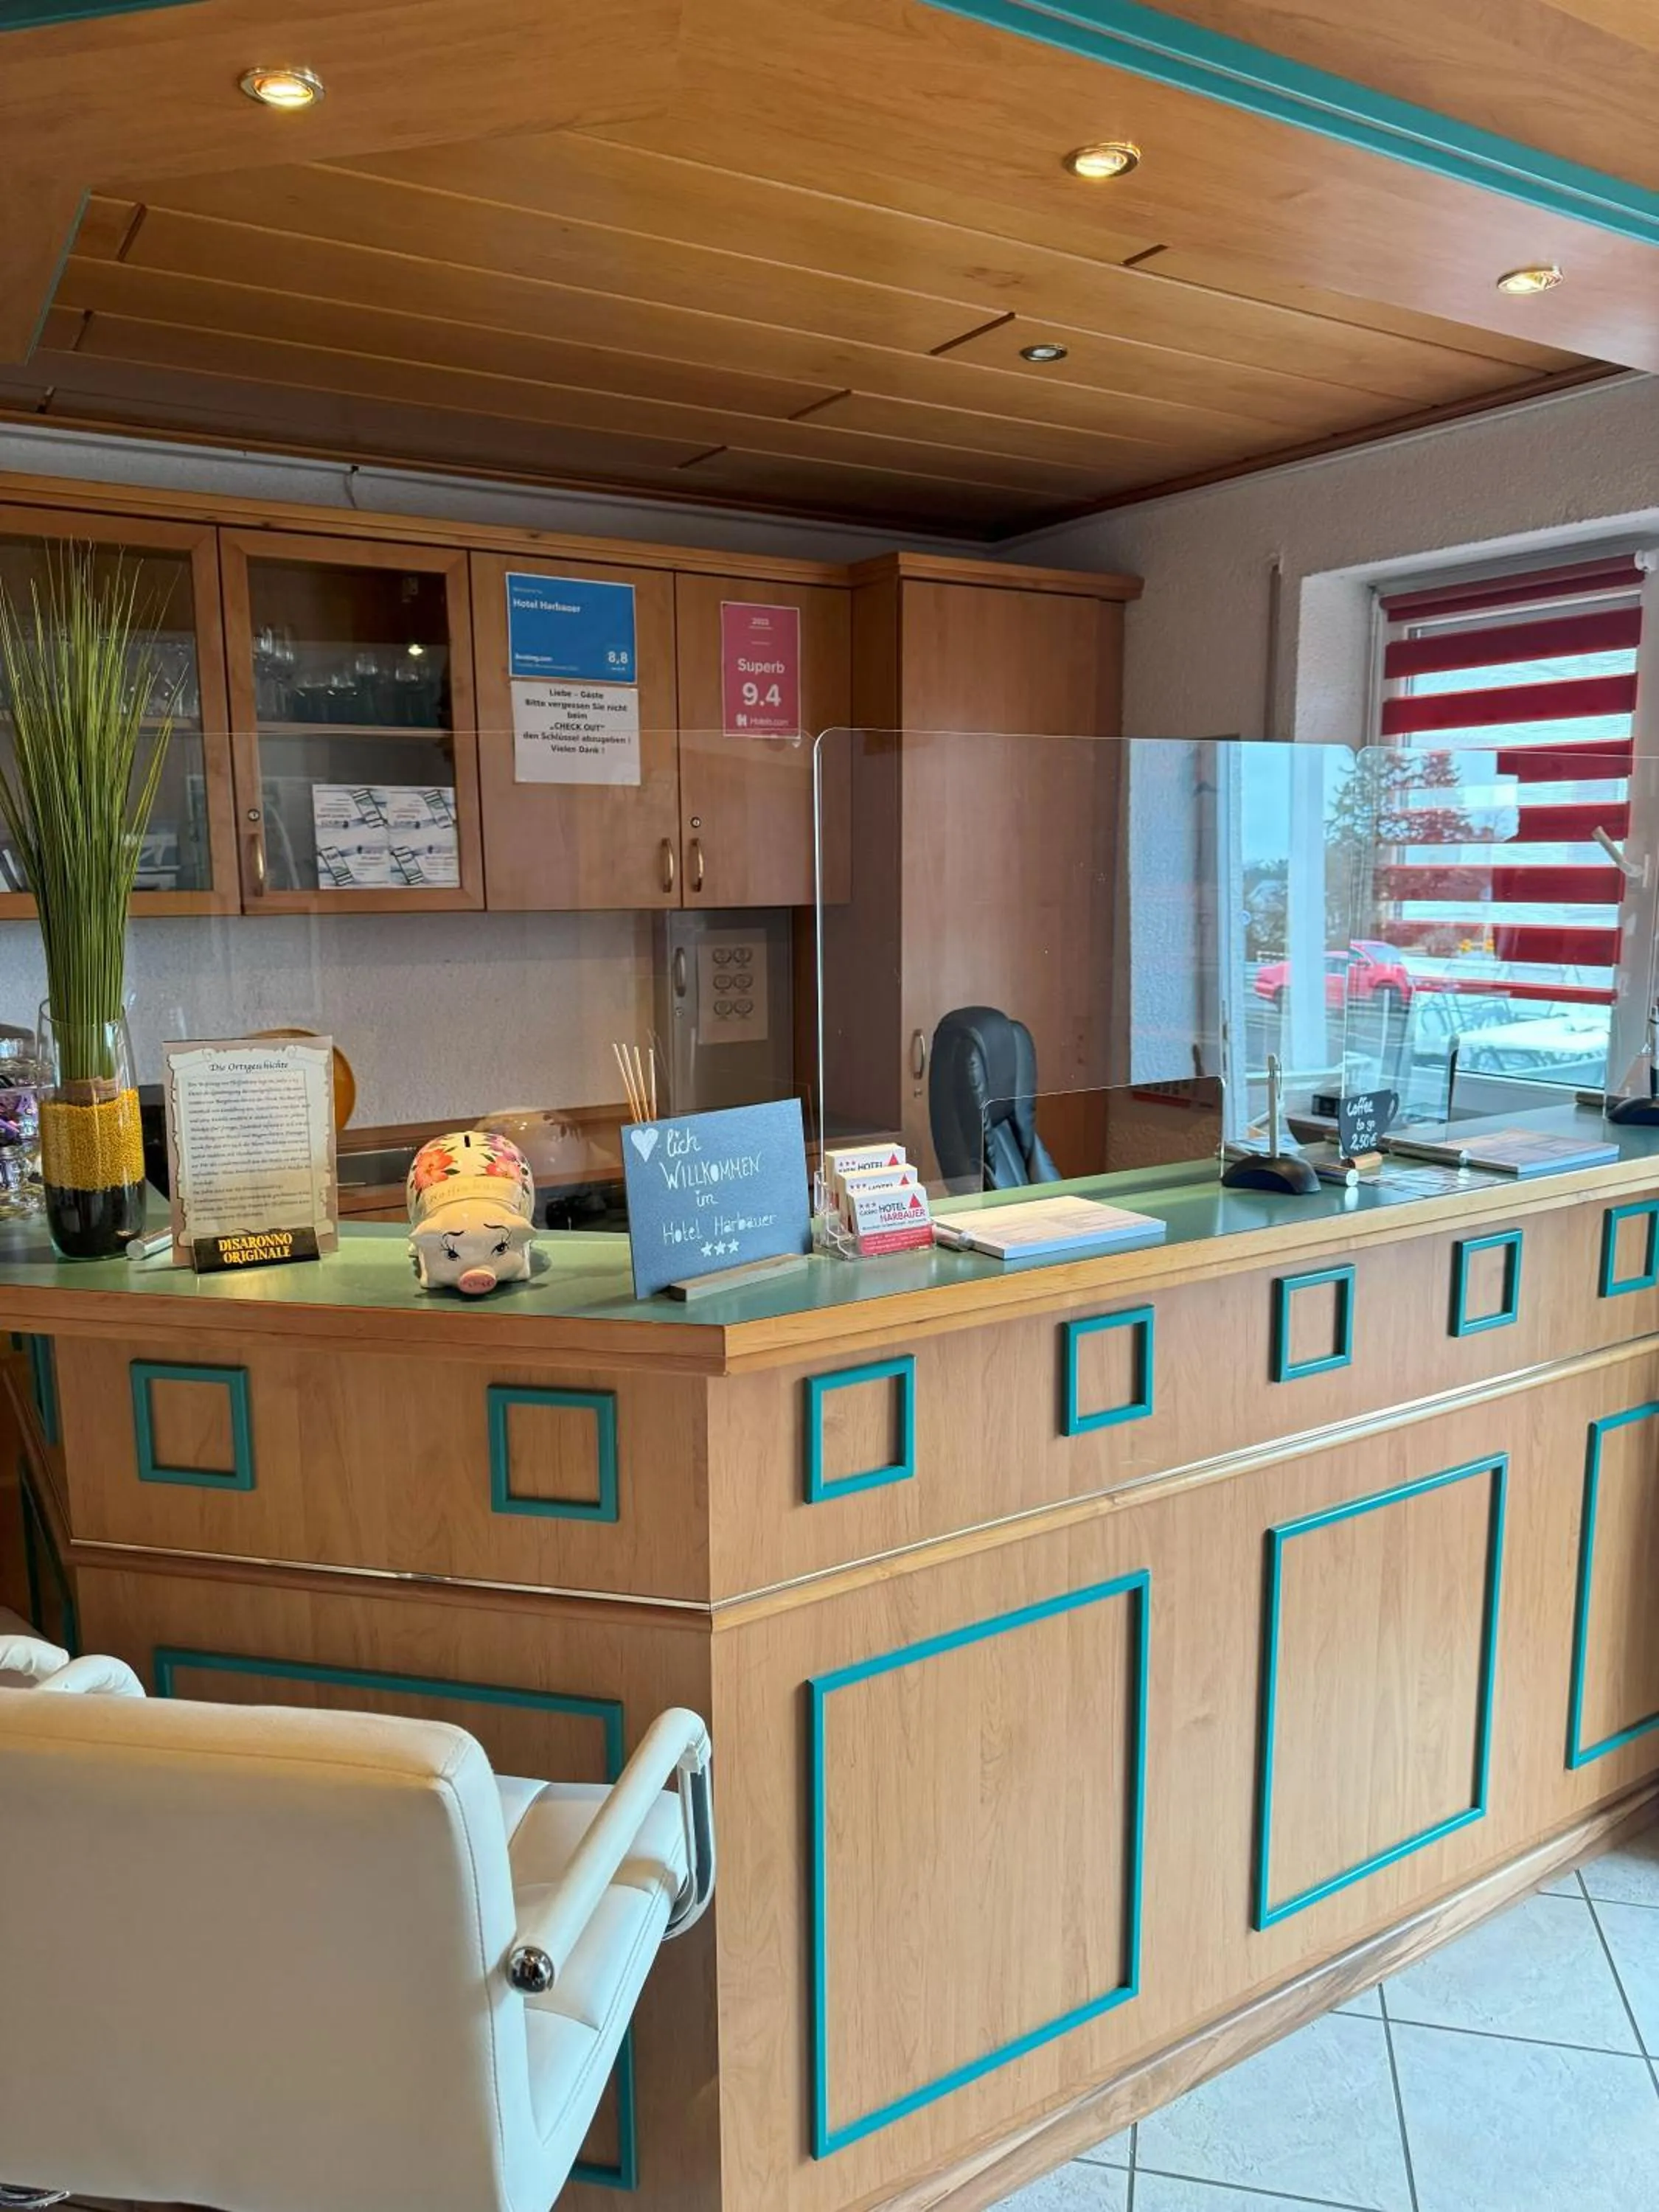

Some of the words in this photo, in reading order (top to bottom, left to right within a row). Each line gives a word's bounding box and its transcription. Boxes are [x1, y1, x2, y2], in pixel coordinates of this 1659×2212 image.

[513, 598, 538, 609] Hotel
[540, 601, 581, 613] Harbauer
[608, 651, 628, 664] 8,8
[737, 658, 785, 675] Superb
[549, 689, 572, 698] Liebe
[742, 682, 782, 707] 9.4
[525, 698, 546, 708] Bitte
[548, 700, 591, 710] vergessen
[592, 703, 605, 711] Sie
[607, 703, 627, 713] nicht
[567, 712, 588, 720] beim
[523, 731, 539, 740] den
[582, 735, 627, 745] abzugeben
[551, 745, 577, 753] Vielen
[579, 746, 599, 754] Dank
[209, 1064, 226, 1072] Die
[1346, 1096, 1374, 1117] Coffee
[1356, 1119, 1365, 1131] to
[1366, 1120, 1376, 1132] go
[658, 1150, 762, 1190] WILLKOMMEN
[695, 1189, 719, 1208] im
[878, 1203, 906, 1213] HOTEL
[880, 1208, 926, 1222] HARBAUER
[663, 1218, 703, 1245] Hotel
[714, 1211, 777, 1237] Harbauer
[218, 1232, 293, 1252] DISARONNO
[223, 1245, 292, 1265] ORIGINALE
